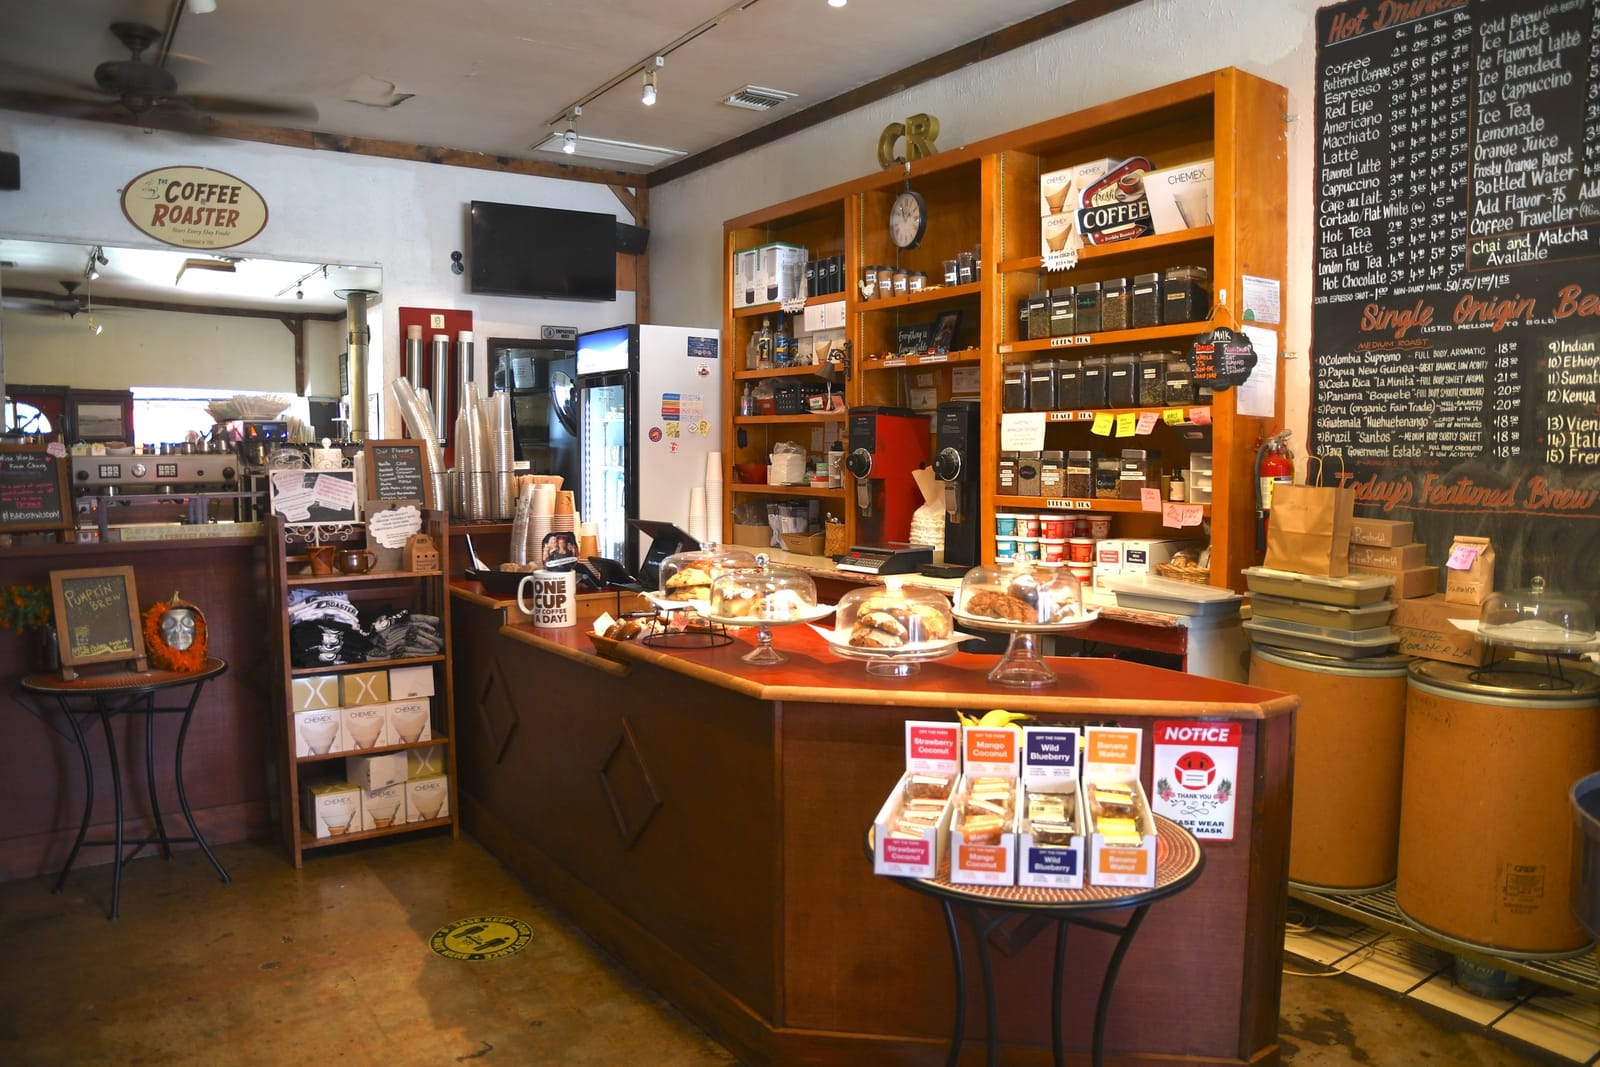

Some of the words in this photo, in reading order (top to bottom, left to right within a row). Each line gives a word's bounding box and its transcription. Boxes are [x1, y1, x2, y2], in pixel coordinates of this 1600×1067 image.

[1328, 7, 1369, 43] Hot
[1480, 17, 1505, 36] Cold
[1511, 9, 1542, 29] Brew
[1482, 36, 1502, 52] Ice
[1477, 55, 1492, 71] Ice
[1497, 39, 1543, 66] Flavored
[1325, 57, 1371, 76] Coffee
[1362, 66, 1390, 82] Coffee
[1478, 71, 1499, 87] Ice
[1505, 52, 1562, 80] Blended
[1325, 83, 1381, 105] Espresso
[1478, 89, 1497, 105] Ice
[1502, 72, 1572, 101] Cappuccino
[1326, 102, 1346, 119] Red
[1351, 100, 1373, 115] Eye
[1478, 109, 1500, 125] Ice
[1506, 102, 1531, 119] Tea
[1323, 113, 1382, 135] Americano
[1476, 115, 1545, 143] Lemonade
[1323, 128, 1380, 151] Macchiato
[1474, 143, 1517, 161] Orange
[1522, 135, 1558, 152] Juice
[1474, 160, 1501, 178] Frosty
[1505, 158, 1538, 173] Orange
[1542, 146, 1573, 168] Burst
[1167, 168, 1206, 185] CHEMEX
[1476, 172, 1526, 196] Bottled
[1532, 166, 1579, 186] Water
[165, 181, 242, 205] COFFEE
[1323, 178, 1380, 197] Cappuccino
[1347, 198, 1360, 208] au
[1383, 202, 1408, 218] White
[1475, 198, 1499, 216] Add
[151, 203, 240, 228] ROASTER
[1083, 201, 1150, 229] COFFEE
[1471, 217, 1513, 236] Coffee
[1517, 204, 1578, 227] Traveller
[1322, 229, 1343, 244] Hot
[1349, 225, 1372, 239] Tea
[1507, 233, 1531, 250] and
[1538, 226, 1588, 247] Matcha
[1320, 246, 1338, 259] Tea
[1486, 246, 1548, 266] Available
[1318, 260, 1343, 276] London
[1345, 258, 1360, 271] Fog
[1365, 254, 1382, 269] Tea
[1322, 275, 1339, 291] Hot
[1342, 269, 1387, 288] Chocolate
[1361, 299, 1434, 339] Single
[1453, 293, 1535, 333] Origin
[1458, 322, 1494, 331] MELLOW
[1358, 341, 1394, 350] MEDIUM
[1365, 351, 1401, 365] Supremo
[1358, 366, 1377, 375] New
[1352, 378, 1370, 388] Rica
[1390, 403, 1407, 412] Fair
[1421, 474, 1521, 508] Featured
[1523, 475, 1599, 510] Brew
[535, 581, 566, 594] ONE
[535, 594, 566, 608] CUP
[535, 615, 541, 623] A
[543, 615, 567, 623] DAY!
[304, 716, 331, 724] CHEMEX
[350, 710, 377, 719] CHEMEX
[914, 737, 953, 747] Strawberry
[1165, 727, 1229, 742] NOTICE
[918, 746, 949, 755] Coconut
[973, 749, 1007, 757] Coconut
[976, 741, 1005, 750] Mango
[1041, 744, 1059, 752] Wild
[1097, 742, 1128, 750] Banana
[1030, 752, 1070, 762] Blueberry
[1098, 751, 1126, 759] Walnut
[414, 783, 440, 792] CHEMEX
[887, 845, 925, 855] Strawberry
[891, 853, 921, 861] Coconut
[1034, 862, 1070, 872] Blueberry
[1044, 856, 1061, 864] Wild
